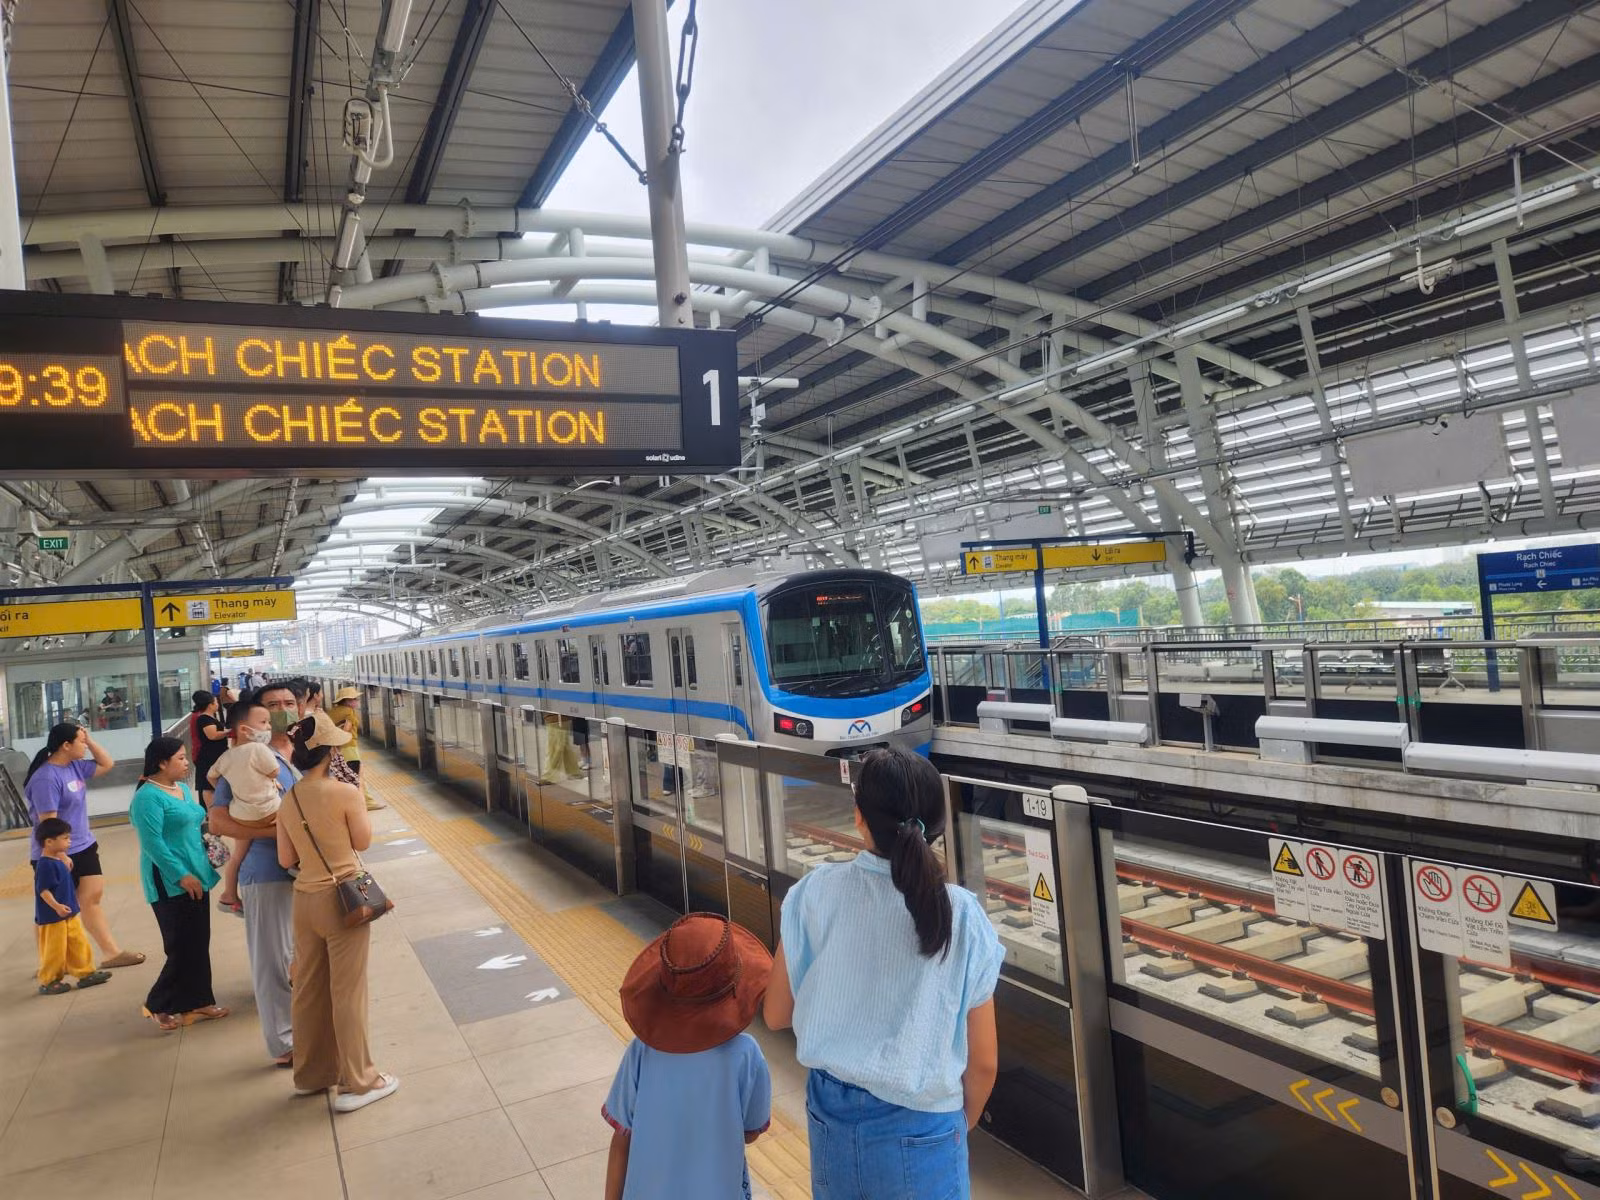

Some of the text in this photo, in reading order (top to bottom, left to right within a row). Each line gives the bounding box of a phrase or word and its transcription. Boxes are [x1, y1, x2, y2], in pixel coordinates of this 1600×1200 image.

[124, 335, 216, 375] CH
[411, 346, 600, 387] STATION
[702, 369, 721, 426] 1
[130, 402, 225, 441] CH
[418, 408, 605, 444] STATION
[43, 538, 64, 549] EXIT
[213, 596, 277, 609] Thang máy
[0, 609, 29, 621] ối ra
[214, 611, 247, 619] Elevator
[1026, 797, 1047, 816] 1-19
